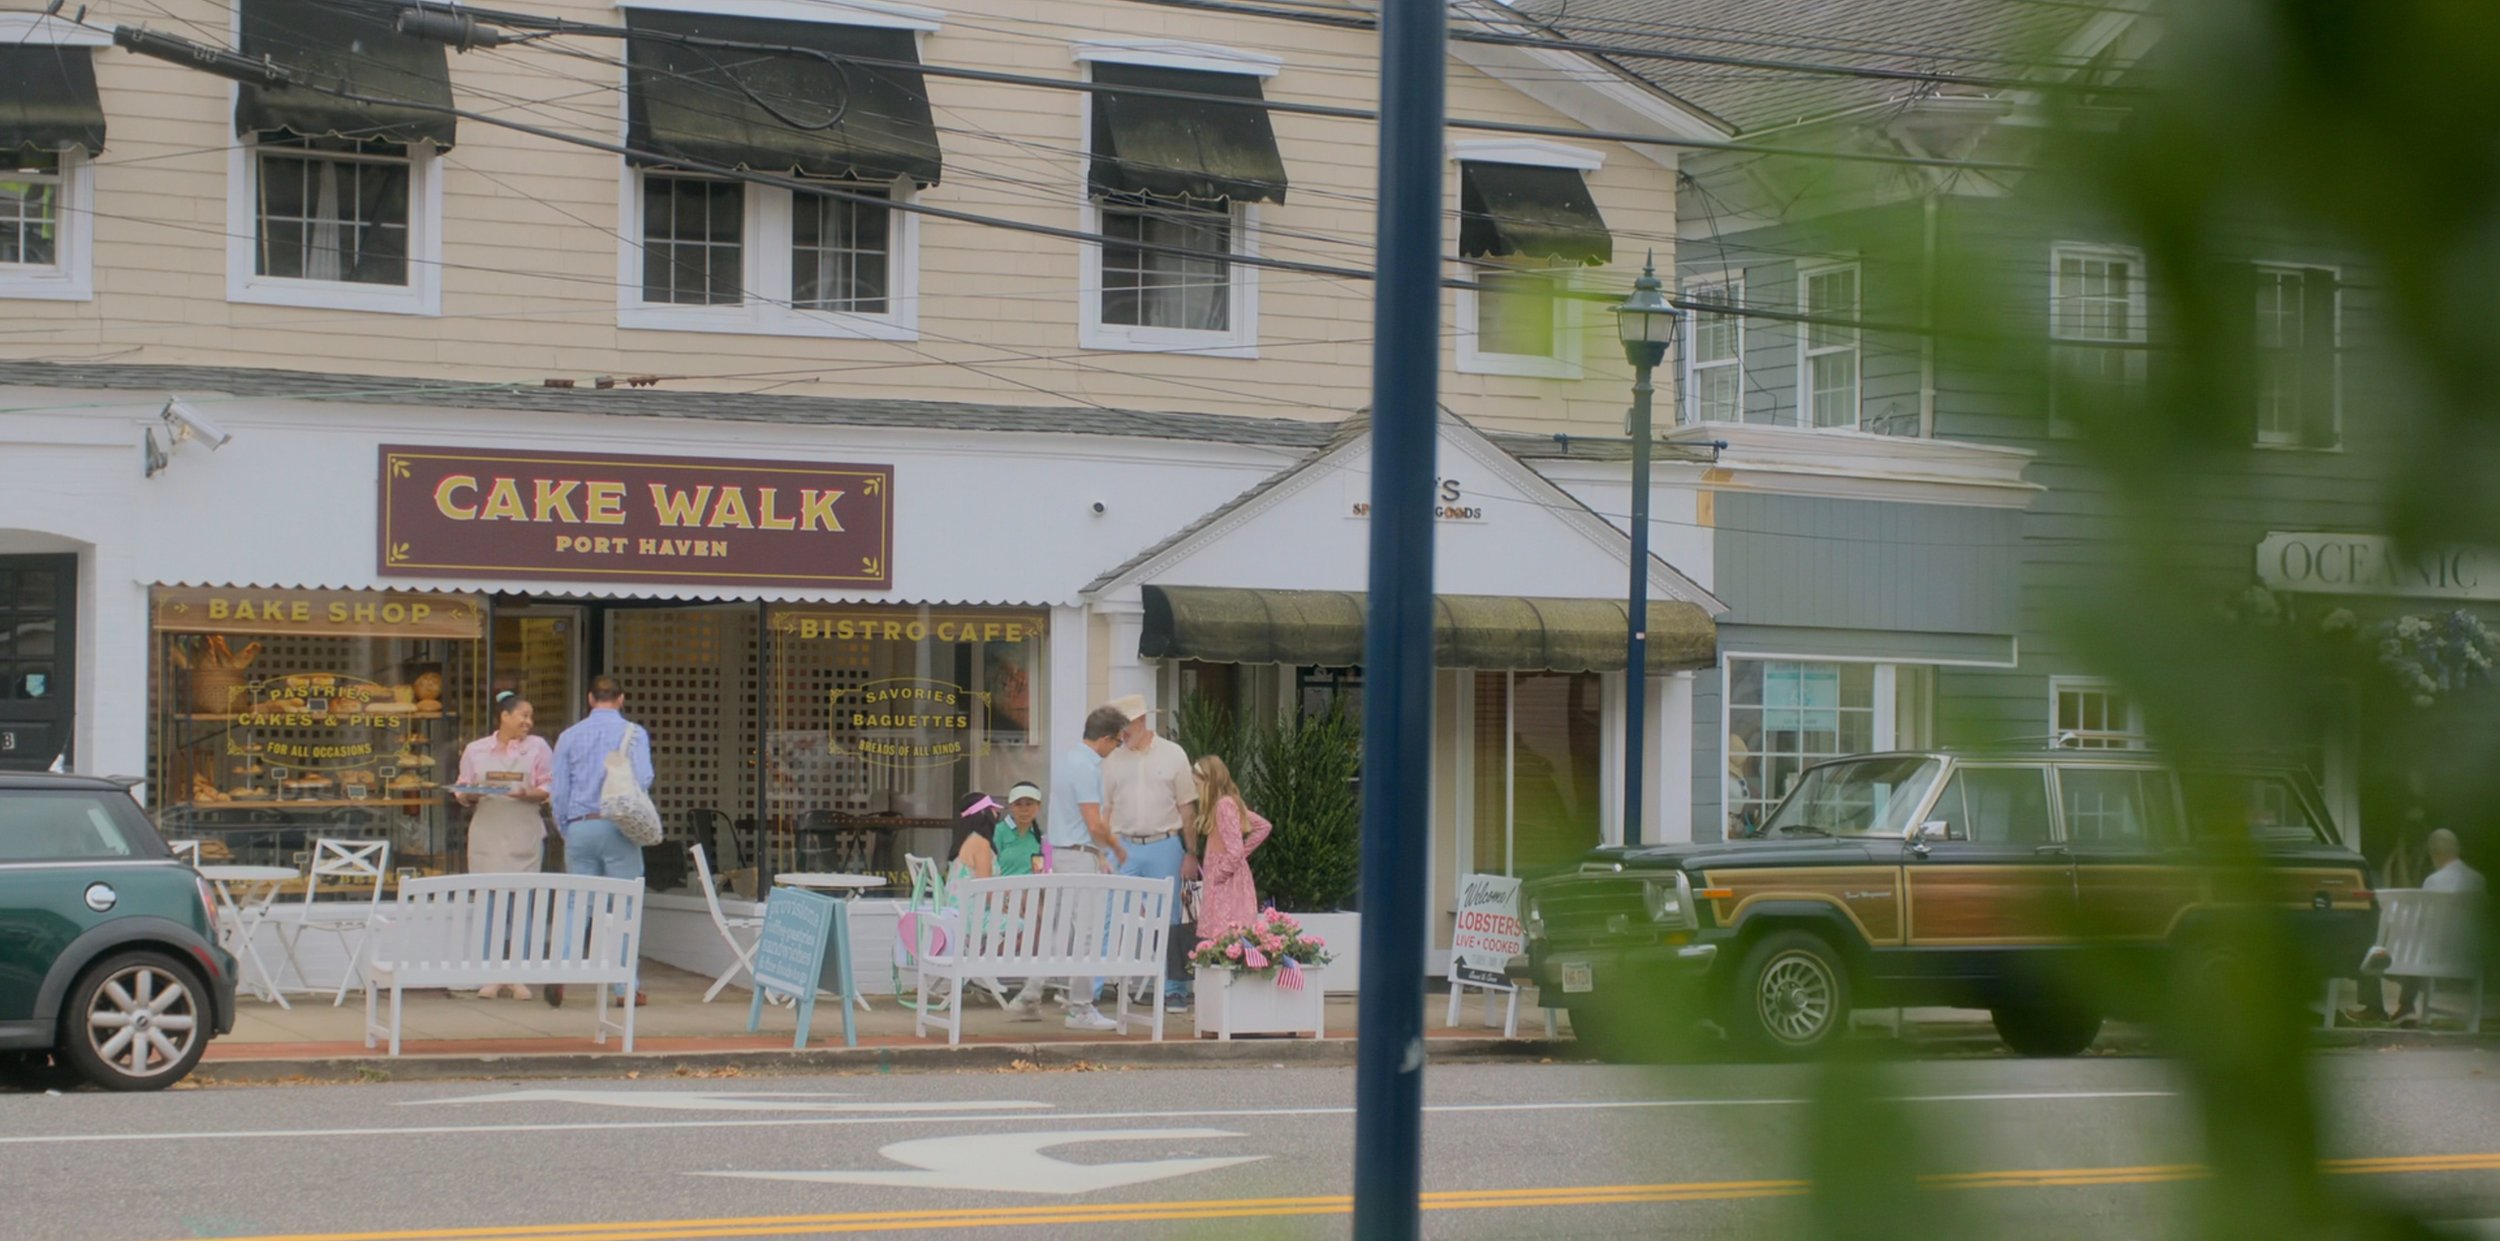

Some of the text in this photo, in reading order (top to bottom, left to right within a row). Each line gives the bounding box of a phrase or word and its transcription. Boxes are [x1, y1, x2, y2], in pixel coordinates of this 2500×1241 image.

[433, 474, 845, 532] CAKE WALK
[1434, 506, 1482, 520] GOODS
[555, 535, 729, 558] PORT HAVEN
[208, 598, 433, 625] BAKE SHOP
[800, 618, 1024, 643] BISTRO CAFE
[269, 684, 373, 704] PASTRIES
[865, 687, 957, 705] SAVORIES
[237, 712, 402, 729] CAKES & PIES
[852, 714, 968, 729] BAGUETTES
[268, 742, 373, 759] FOR ALL OCCASIONS
[859, 740, 963, 757] BREADS OF ALL KINDS
[1458, 910, 1522, 937] LOBSTERS
[1456, 934, 1520, 955] LIVE COOKED
